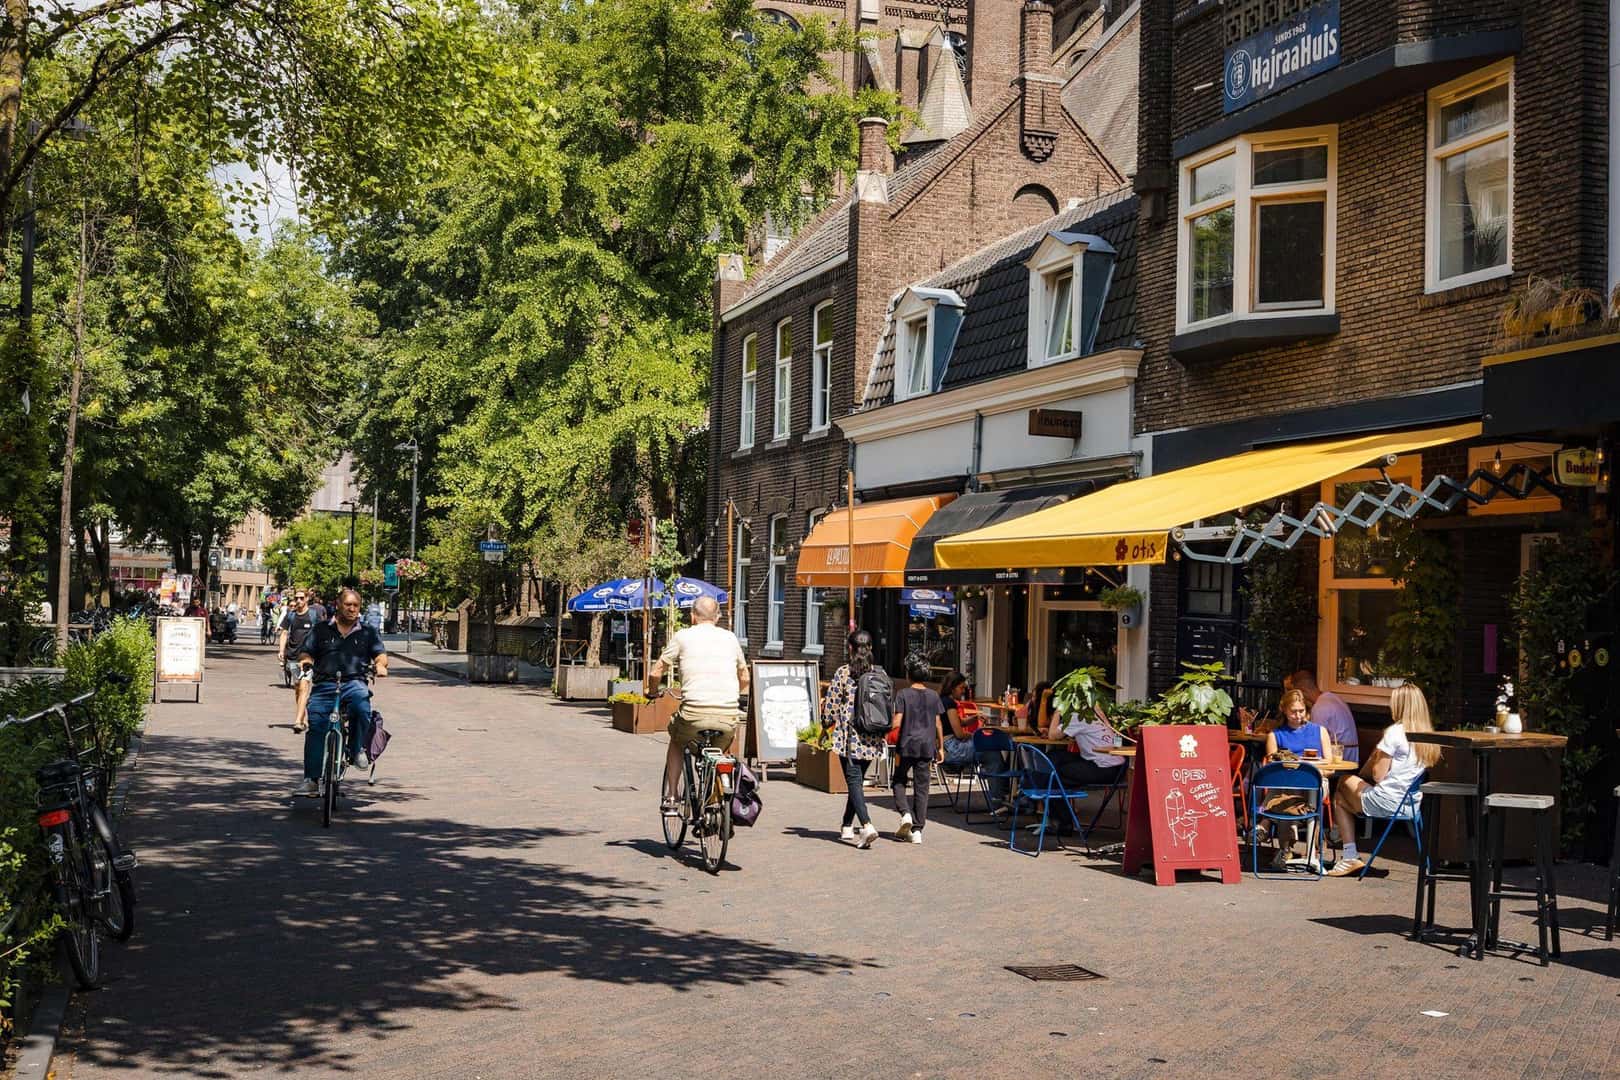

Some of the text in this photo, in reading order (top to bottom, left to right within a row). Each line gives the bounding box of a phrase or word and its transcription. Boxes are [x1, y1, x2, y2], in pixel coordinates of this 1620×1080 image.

[1251, 23, 1337, 90] HajraaHuis
[1132, 538, 1156, 560] otis
[1172, 768, 1207, 784] OPEN
